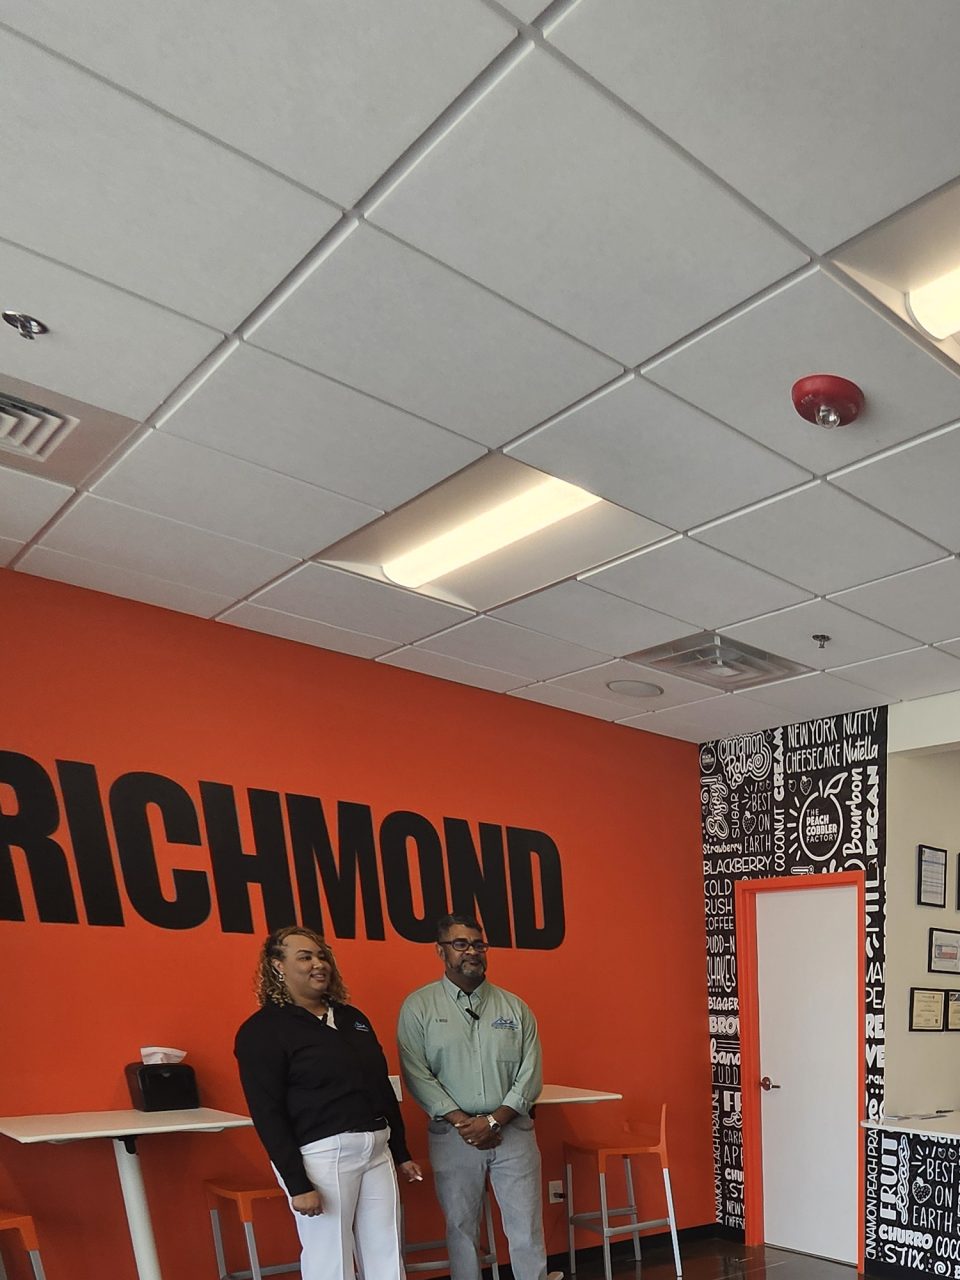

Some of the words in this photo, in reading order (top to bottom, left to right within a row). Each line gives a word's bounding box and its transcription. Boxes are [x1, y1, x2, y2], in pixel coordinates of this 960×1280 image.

[842, 707, 879, 738] NUTTY
[773, 727, 785, 801] CREAM
[786, 744, 841, 774] CHEESECAKE
[843, 735, 879, 767] Nutella
[751, 791, 772, 812] BEST
[806, 808, 819, 816] THE
[842, 767, 864, 857] Bourbon
[866, 765, 879, 856] PECAN
[758, 813, 771, 832] ON
[806, 814, 829, 826] PEACH
[806, 823, 838, 836] COBBLER
[0, 750, 566, 950] RICHMOND
[744, 834, 771, 854] EARTH
[774, 807, 786, 871] COCONUT
[806, 834, 838, 843] FACTORY
[703, 855, 773, 875] BLACKBERRY
[866, 1160, 878, 1198] PEACH
[879, 1133, 898, 1221] FRUIT
[926, 1158, 957, 1184] BEST
[934, 1185, 954, 1208] ON
[865, 1198, 878, 1260] CINNAMON
[912, 1205, 954, 1234] EARTH
[878, 1224, 933, 1250] CHURRO
[884, 1243, 925, 1270] STIX
